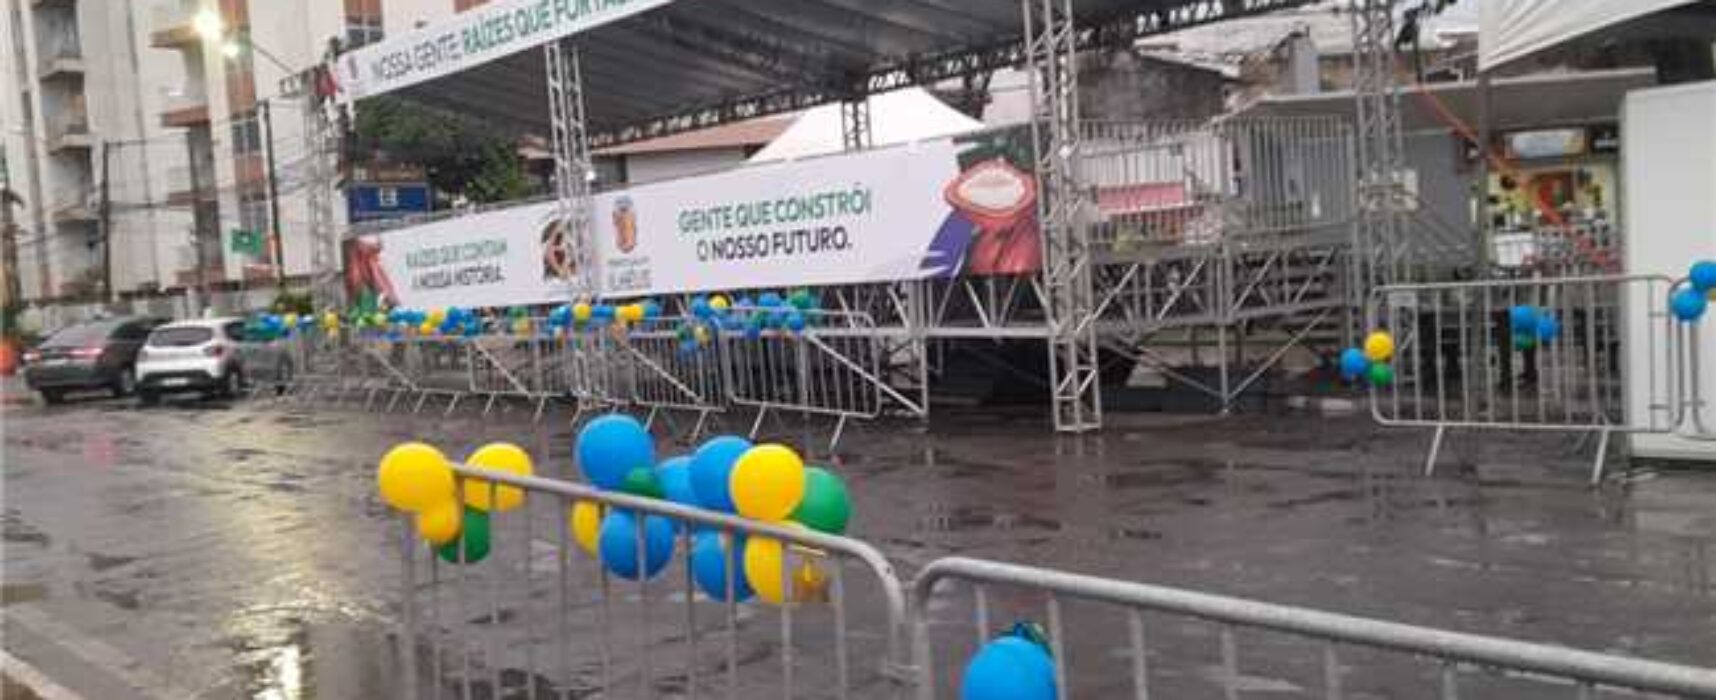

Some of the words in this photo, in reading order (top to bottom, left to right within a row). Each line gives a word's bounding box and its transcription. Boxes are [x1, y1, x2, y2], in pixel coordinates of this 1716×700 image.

[515, 0, 552, 36] QUE
[679, 205, 732, 232] GENTE
[736, 200, 772, 227] QUE
[697, 239, 708, 262] O
[712, 233, 768, 260] NOSSO
[773, 226, 853, 255] FUTURO.
